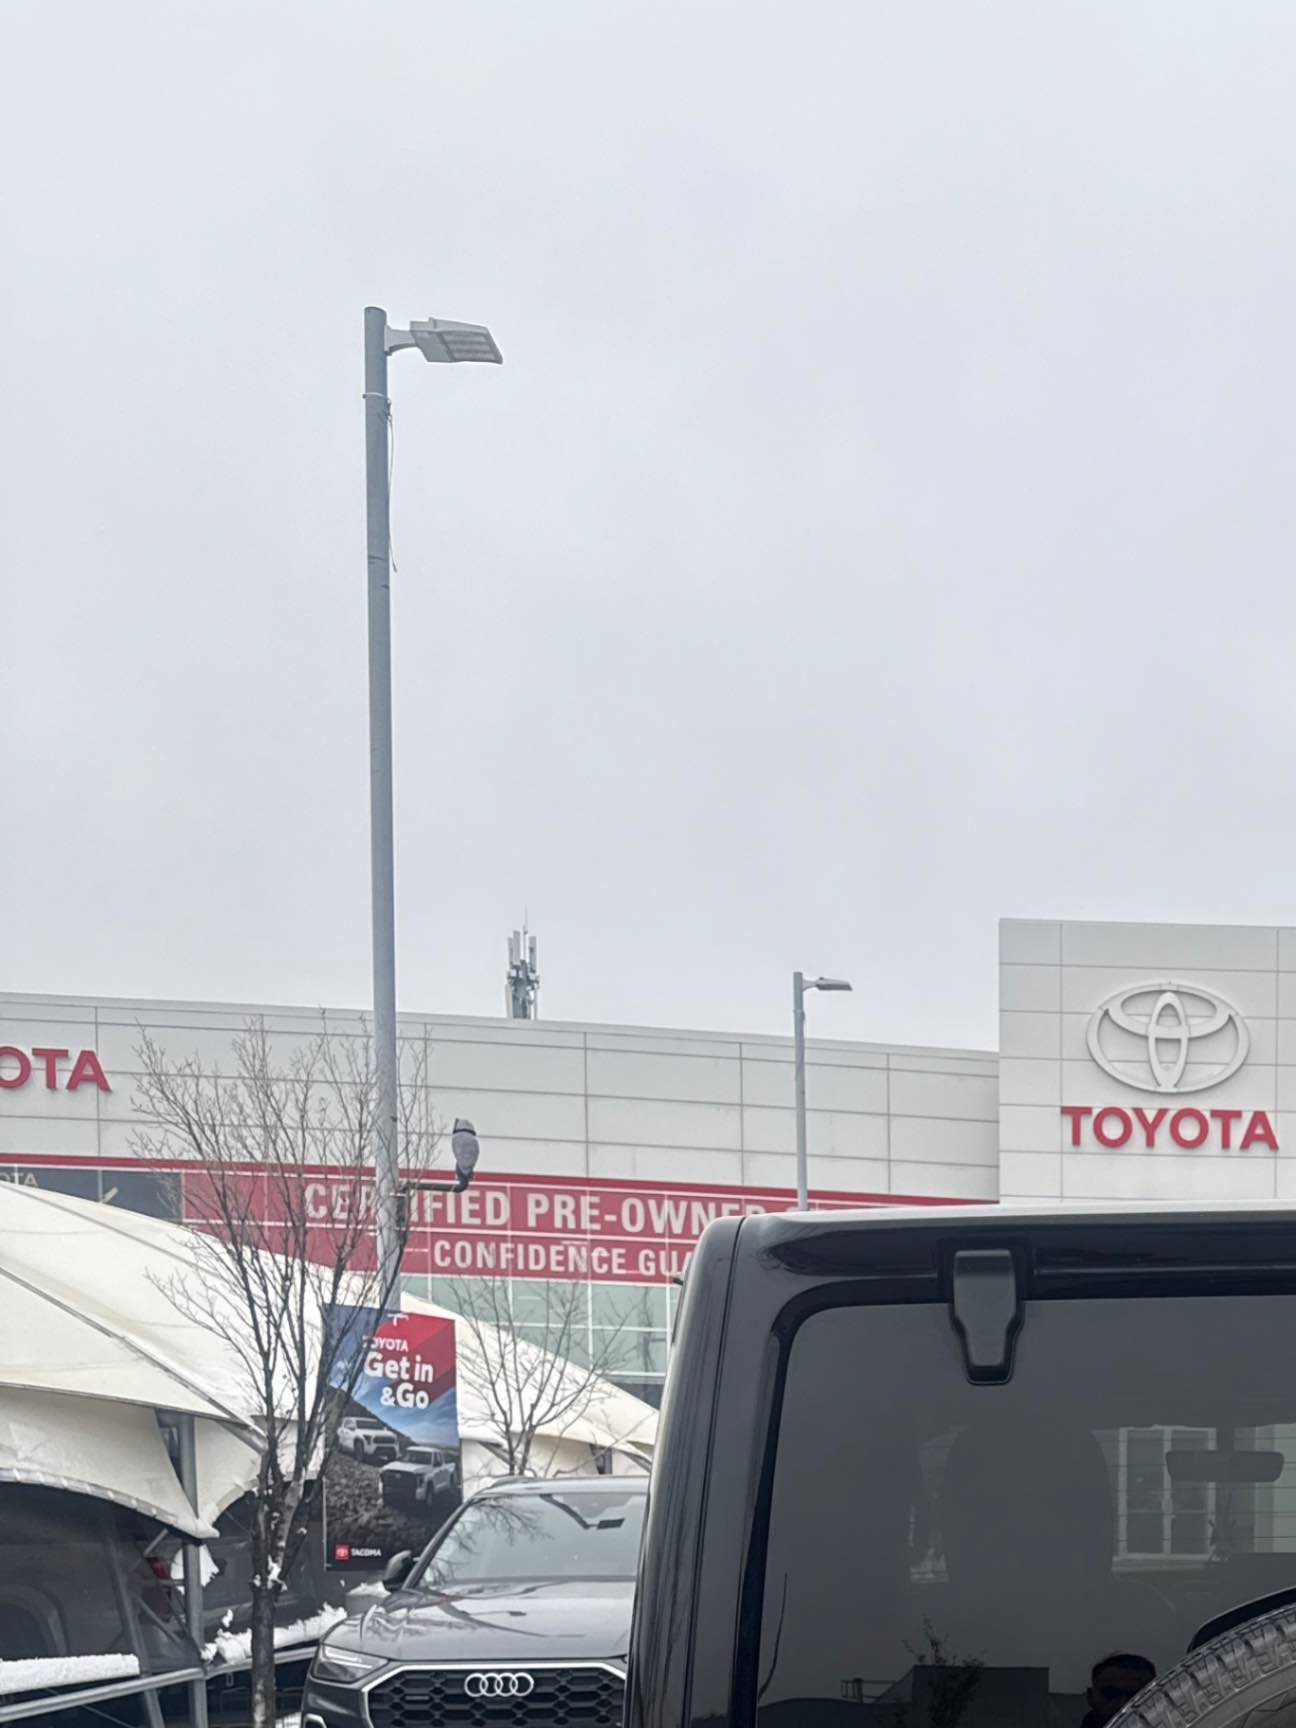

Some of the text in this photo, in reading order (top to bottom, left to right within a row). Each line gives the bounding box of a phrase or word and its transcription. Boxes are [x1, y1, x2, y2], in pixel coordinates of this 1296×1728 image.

[0, 1046, 112, 1092] OTA
[1061, 1106, 1279, 1150] TOYOTA
[304, 1183, 767, 1236] CERIFIED PRE-OWN
[434, 1240, 626, 1275] CONFIDENCE
[363, 1351, 434, 1383] Get in
[380, 1382, 429, 1409] &Go
